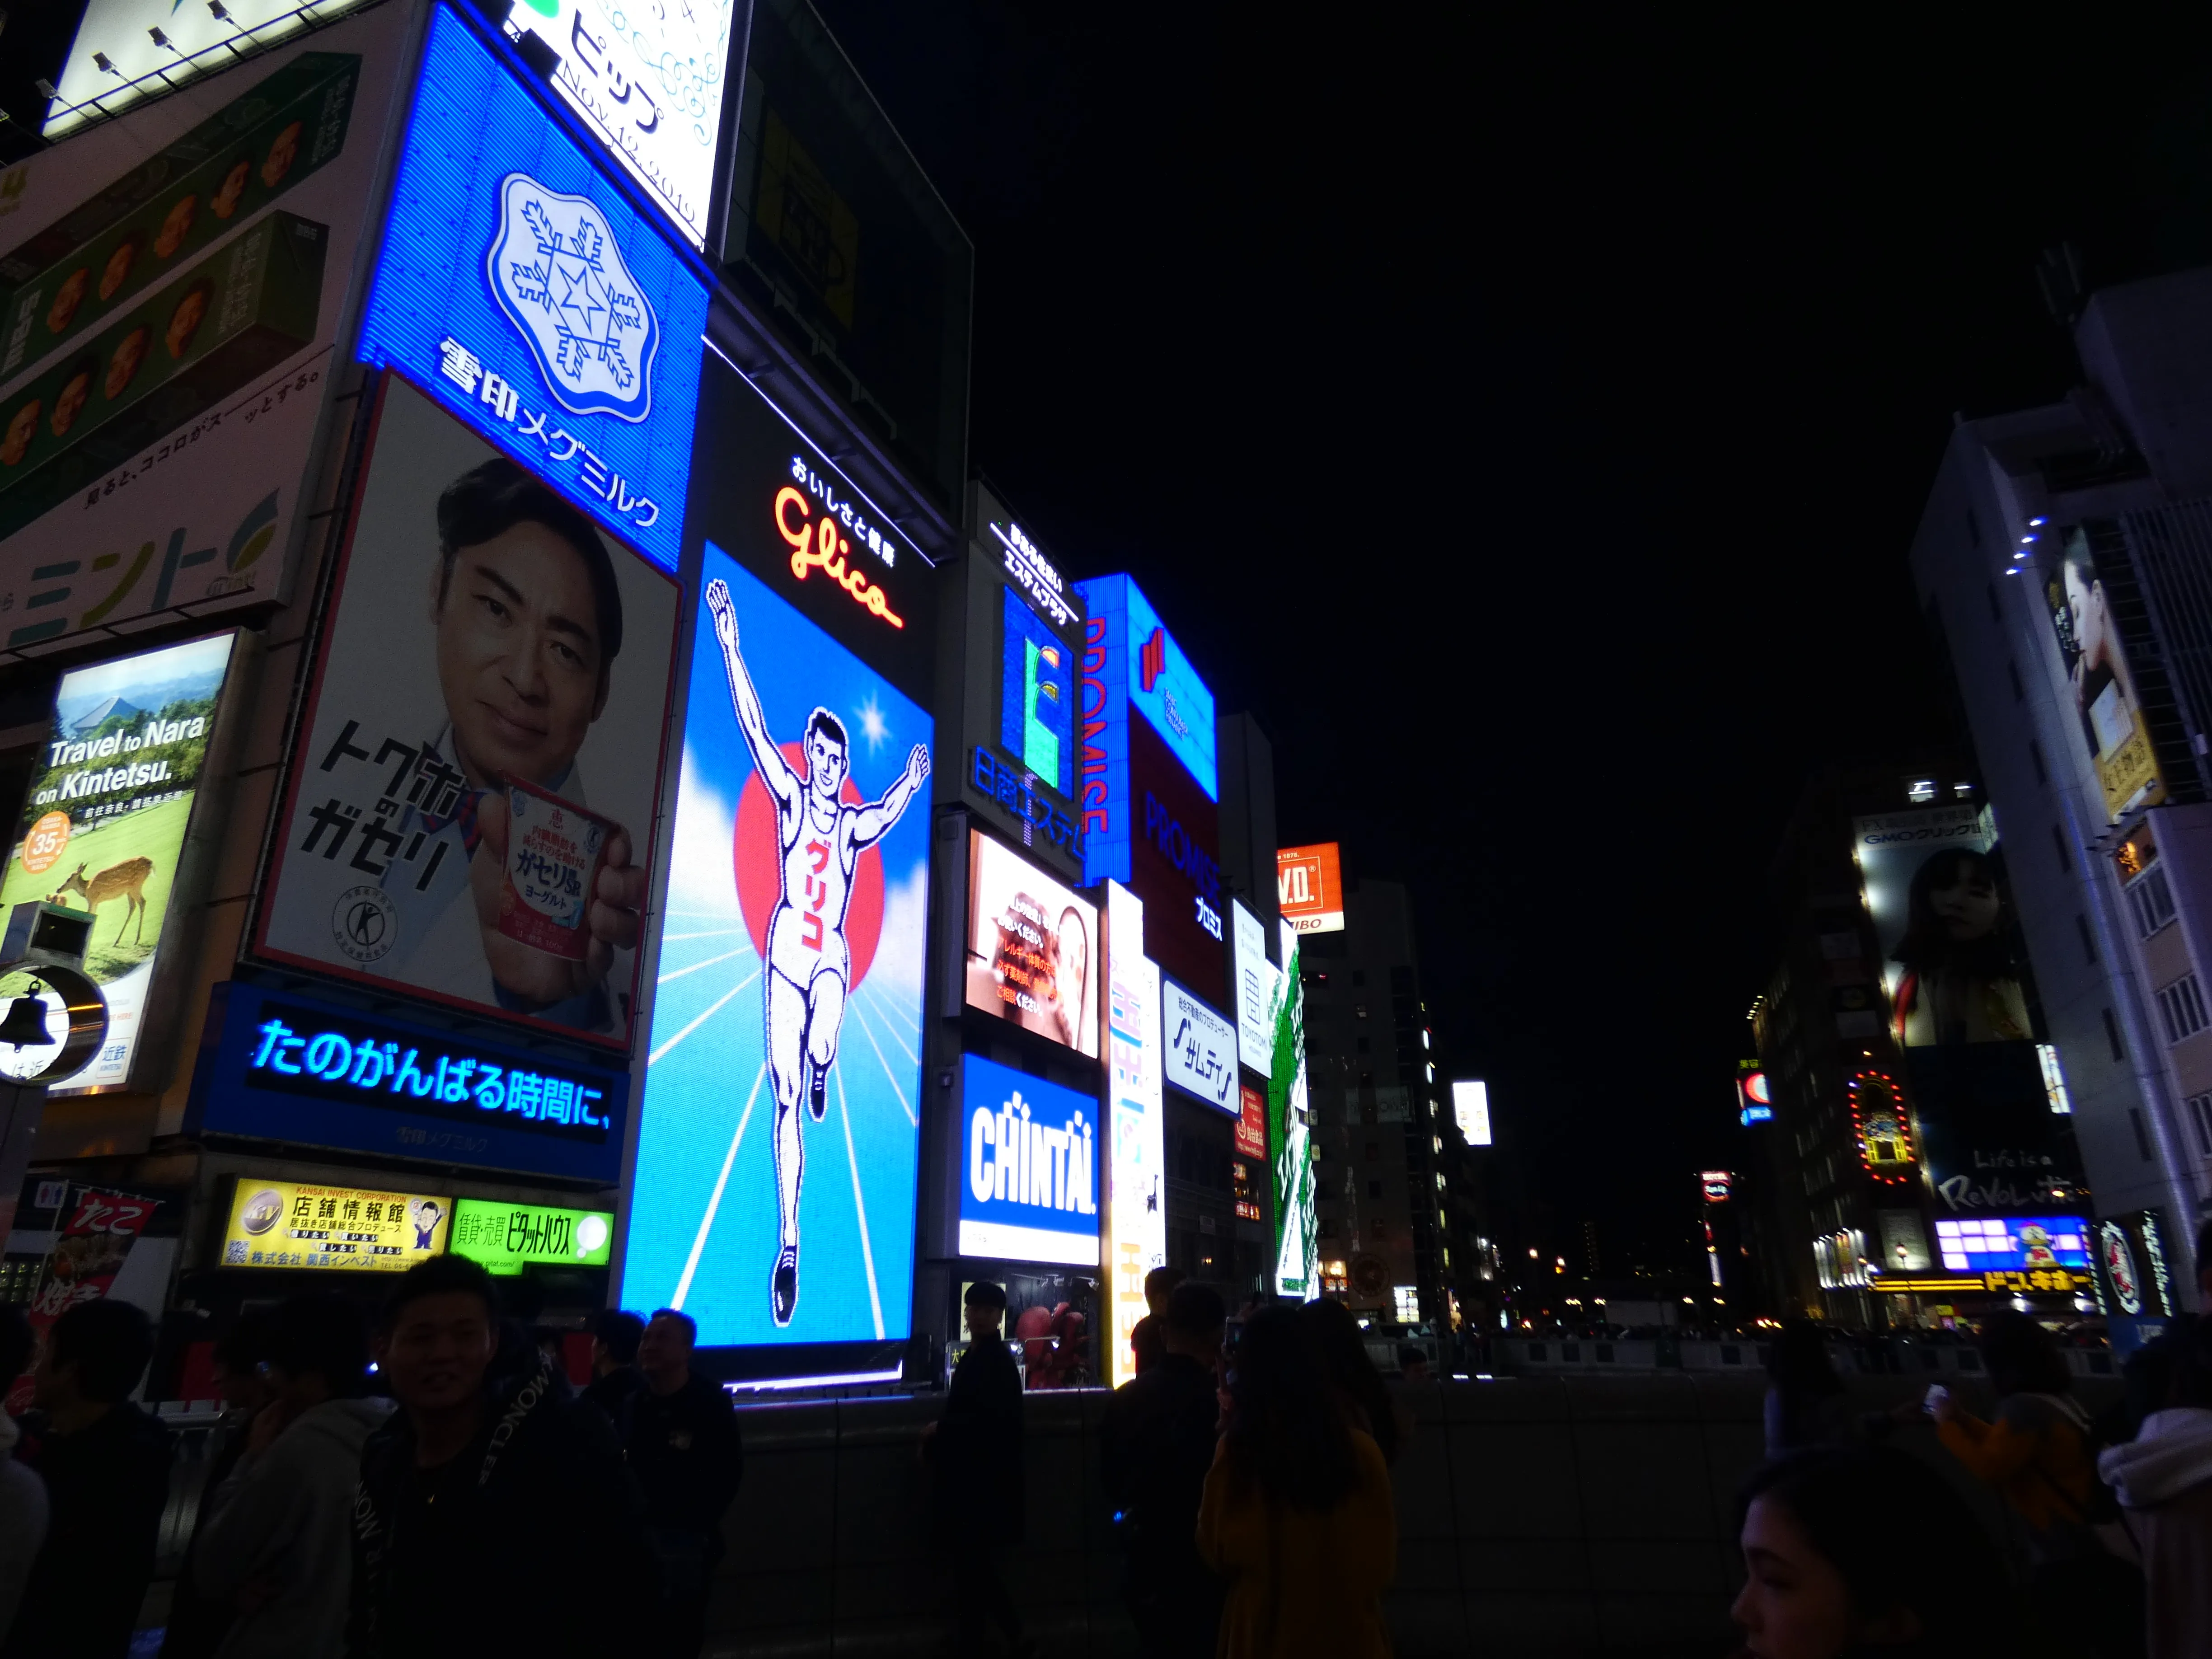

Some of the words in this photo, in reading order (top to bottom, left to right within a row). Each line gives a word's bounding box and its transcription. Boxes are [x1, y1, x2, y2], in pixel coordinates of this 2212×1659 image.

[572, 8, 664, 134] ピップ
[440, 336, 659, 527] 雪印メグミルク
[775, 487, 903, 629] Glico
[51, 729, 124, 767] Travel
[124, 736, 141, 752] to
[144, 717, 205, 747] Nara
[36, 788, 57, 805] on
[61, 761, 172, 801] Kintetsu.
[33, 831, 58, 855] 35
[301, 799, 449, 891] ガセリ
[801, 838, 832, 953] グリコ
[1195, 896, 1223, 942] プロミス
[103, 1044, 127, 1061] 近鉄
[253, 1018, 610, 1129] たのがんばる時間に、
[1184, 1037, 1223, 1085] サムティ
[1973, 1148, 2016, 1168] Life
[293, 1195, 405, 1223] 店舗情報館
[296, 1186, 325, 1196] KANSAI
[327, 1189, 353, 1199] INVEST
[356, 1192, 406, 1203] CORPORATION
[290, 1217, 401, 1233] 居抜き店舗総合プロデュース
[506, 1211, 571, 1256] ピタットハウス
[251, 1250, 302, 1265] 株式会社
[305, 1252, 377, 1268] 関西インベスト
[477, 1368, 550, 1488] MONCLER
